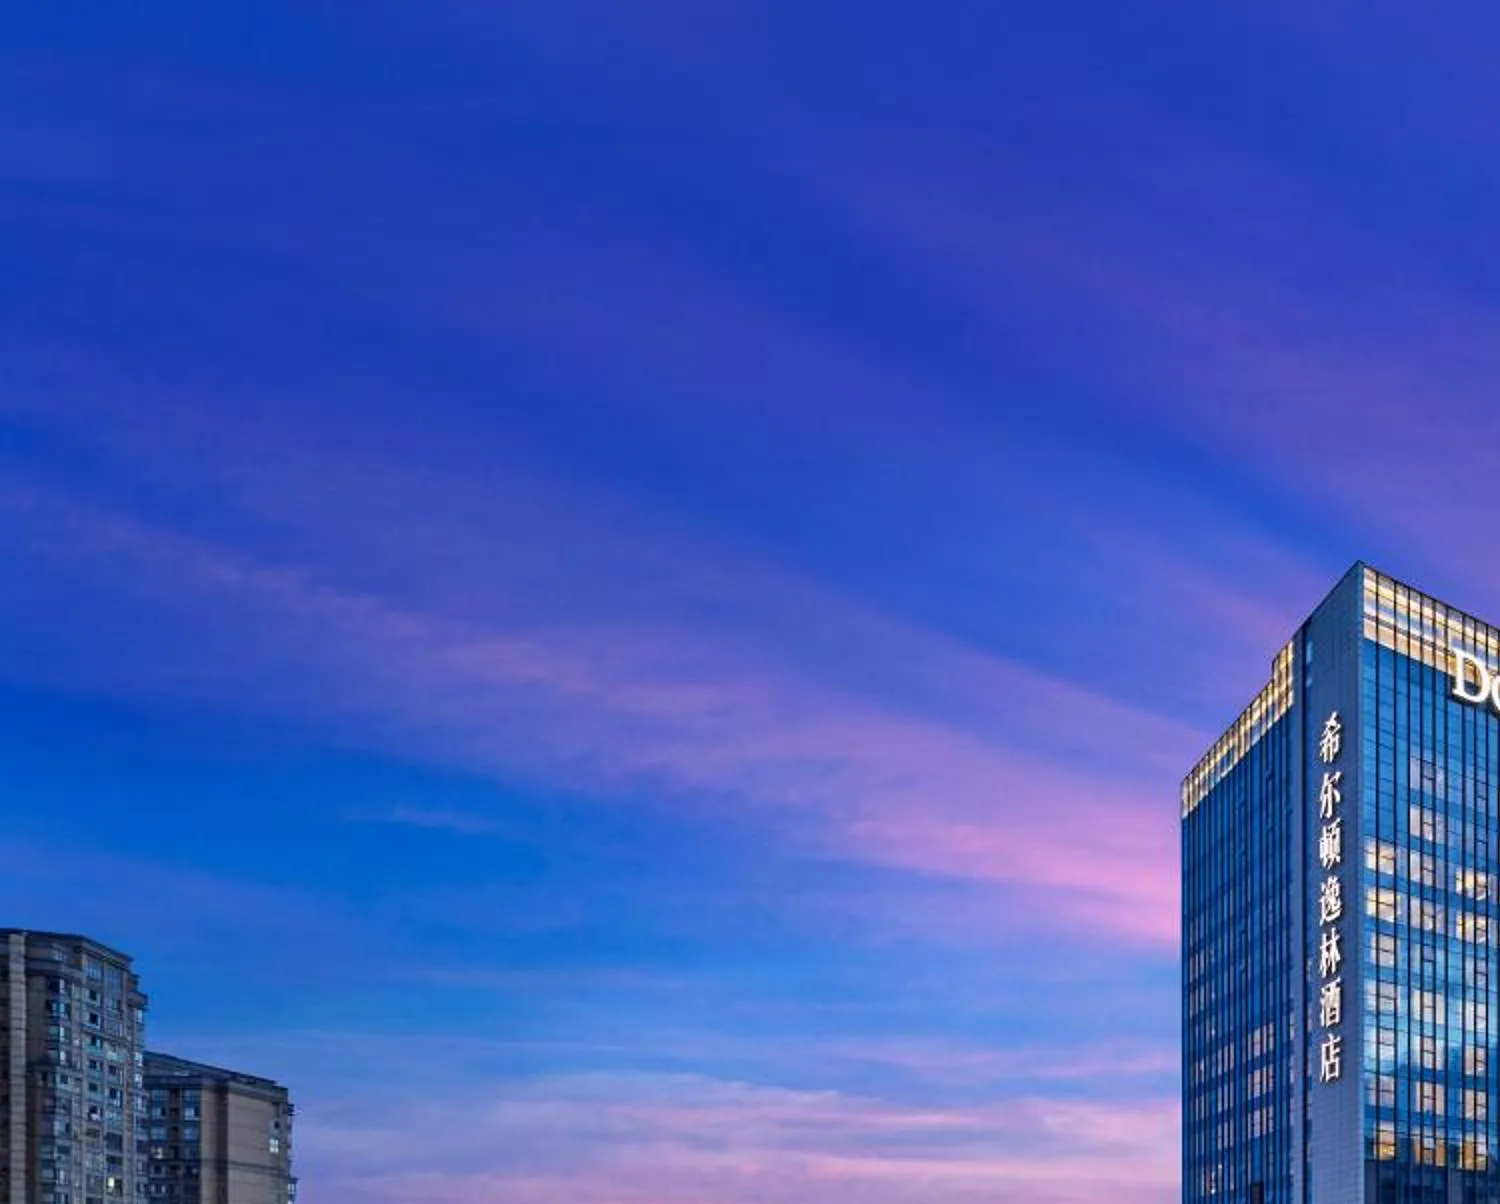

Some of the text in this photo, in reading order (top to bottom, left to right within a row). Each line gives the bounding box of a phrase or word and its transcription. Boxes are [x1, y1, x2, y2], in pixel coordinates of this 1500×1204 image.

[1319, 711, 1342, 1083] 希尔顿逸林酒店
